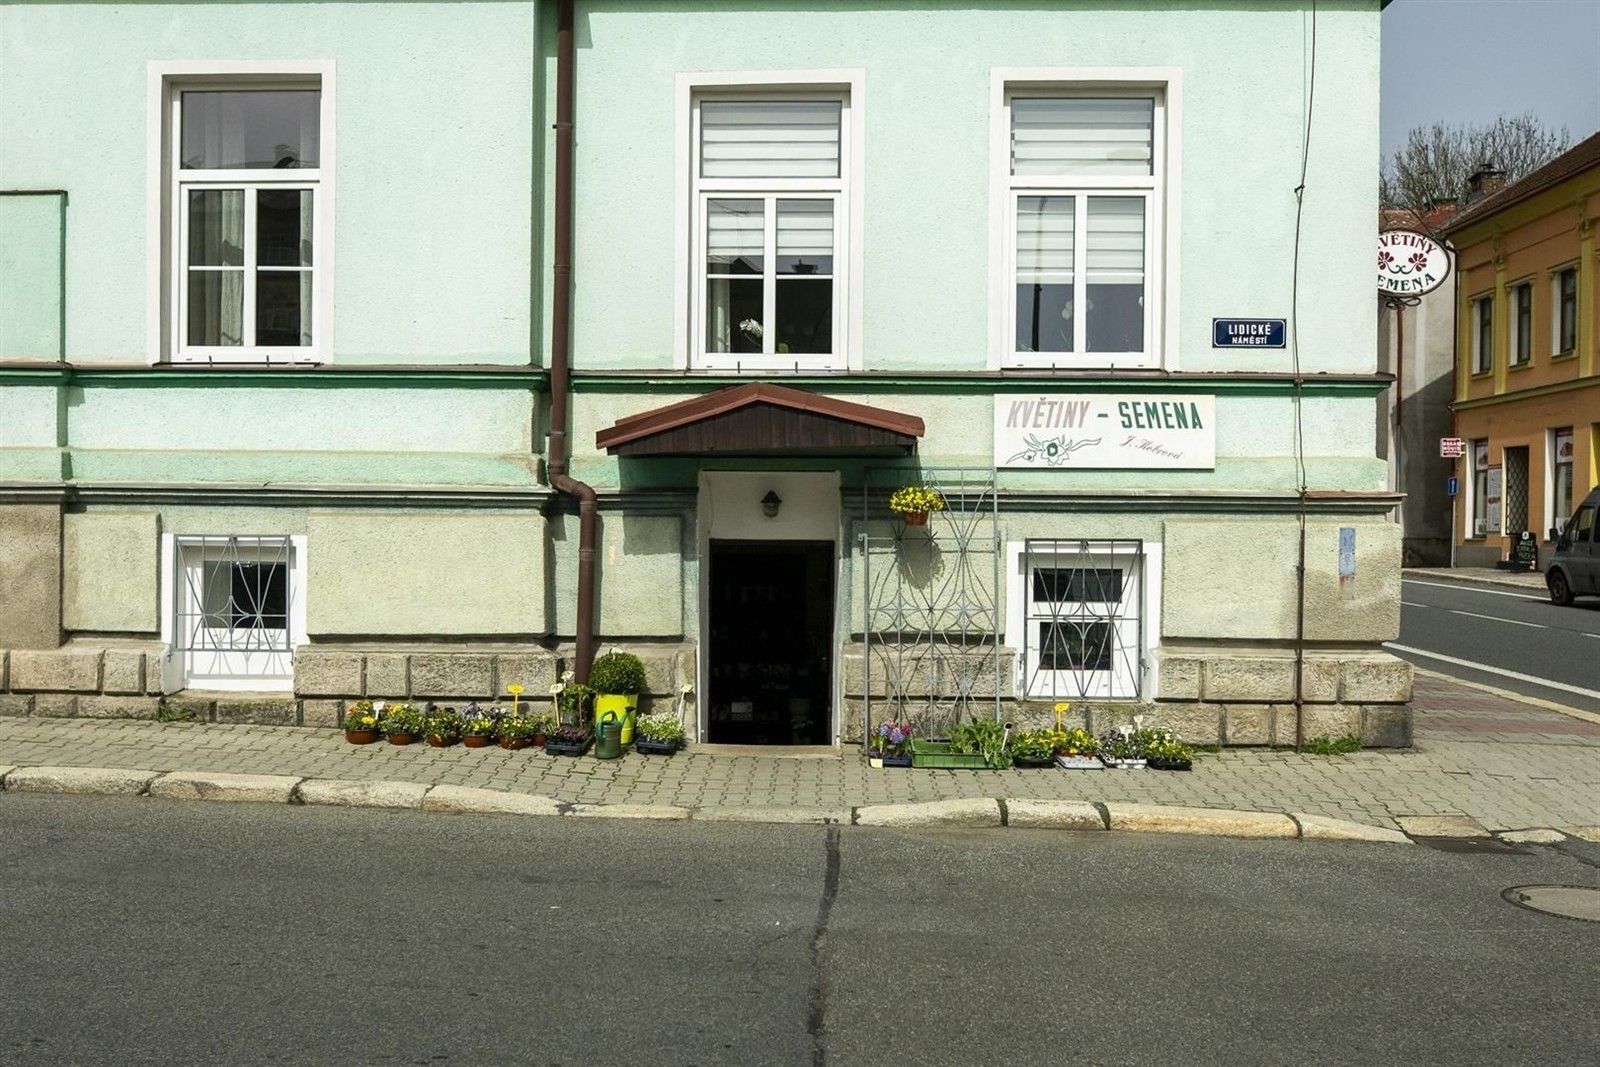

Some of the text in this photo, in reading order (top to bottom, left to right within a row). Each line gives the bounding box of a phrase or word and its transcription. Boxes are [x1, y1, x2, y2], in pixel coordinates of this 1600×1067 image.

[1378, 273, 1437, 292] EMENA
[1228, 322, 1272, 335] LIDICKÉ
[1232, 335, 1267, 345] NÁMĚSTÍ
[1006, 397, 1091, 428] KVĚTINY
[1118, 401, 1203, 430] SEMENA
